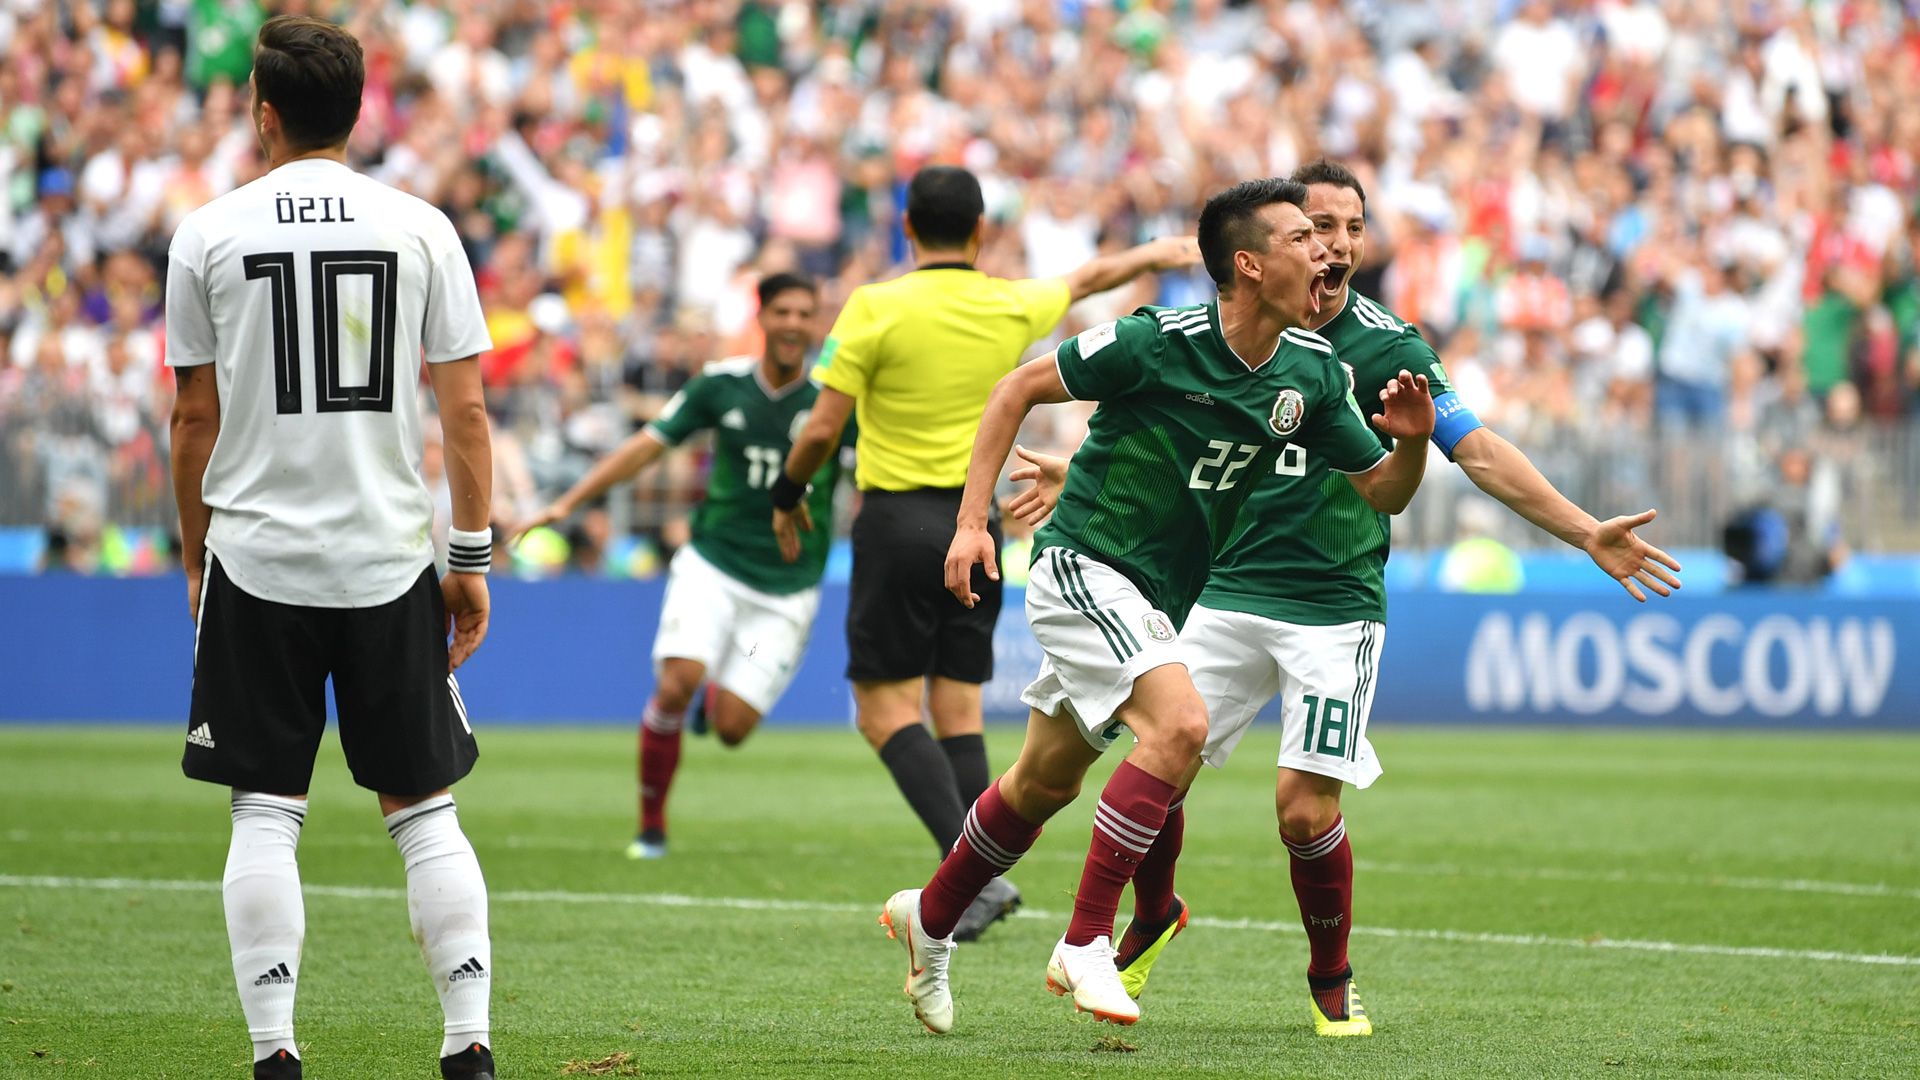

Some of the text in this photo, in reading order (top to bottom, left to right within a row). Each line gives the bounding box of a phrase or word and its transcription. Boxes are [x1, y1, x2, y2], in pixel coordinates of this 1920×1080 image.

[276, 192, 355, 223] ÖZIL
[243, 251, 398, 414] 10
[1185, 392, 1215, 406] adidas
[1189, 439, 1262, 491] 22
[1466, 611, 1895, 717] MOSCOW
[1303, 695, 1348, 758] 18
[187, 734, 215, 748] adidas
[1310, 913, 1343, 928] FMF
[254, 976, 294, 986] adidas
[449, 970, 489, 982] adidas
